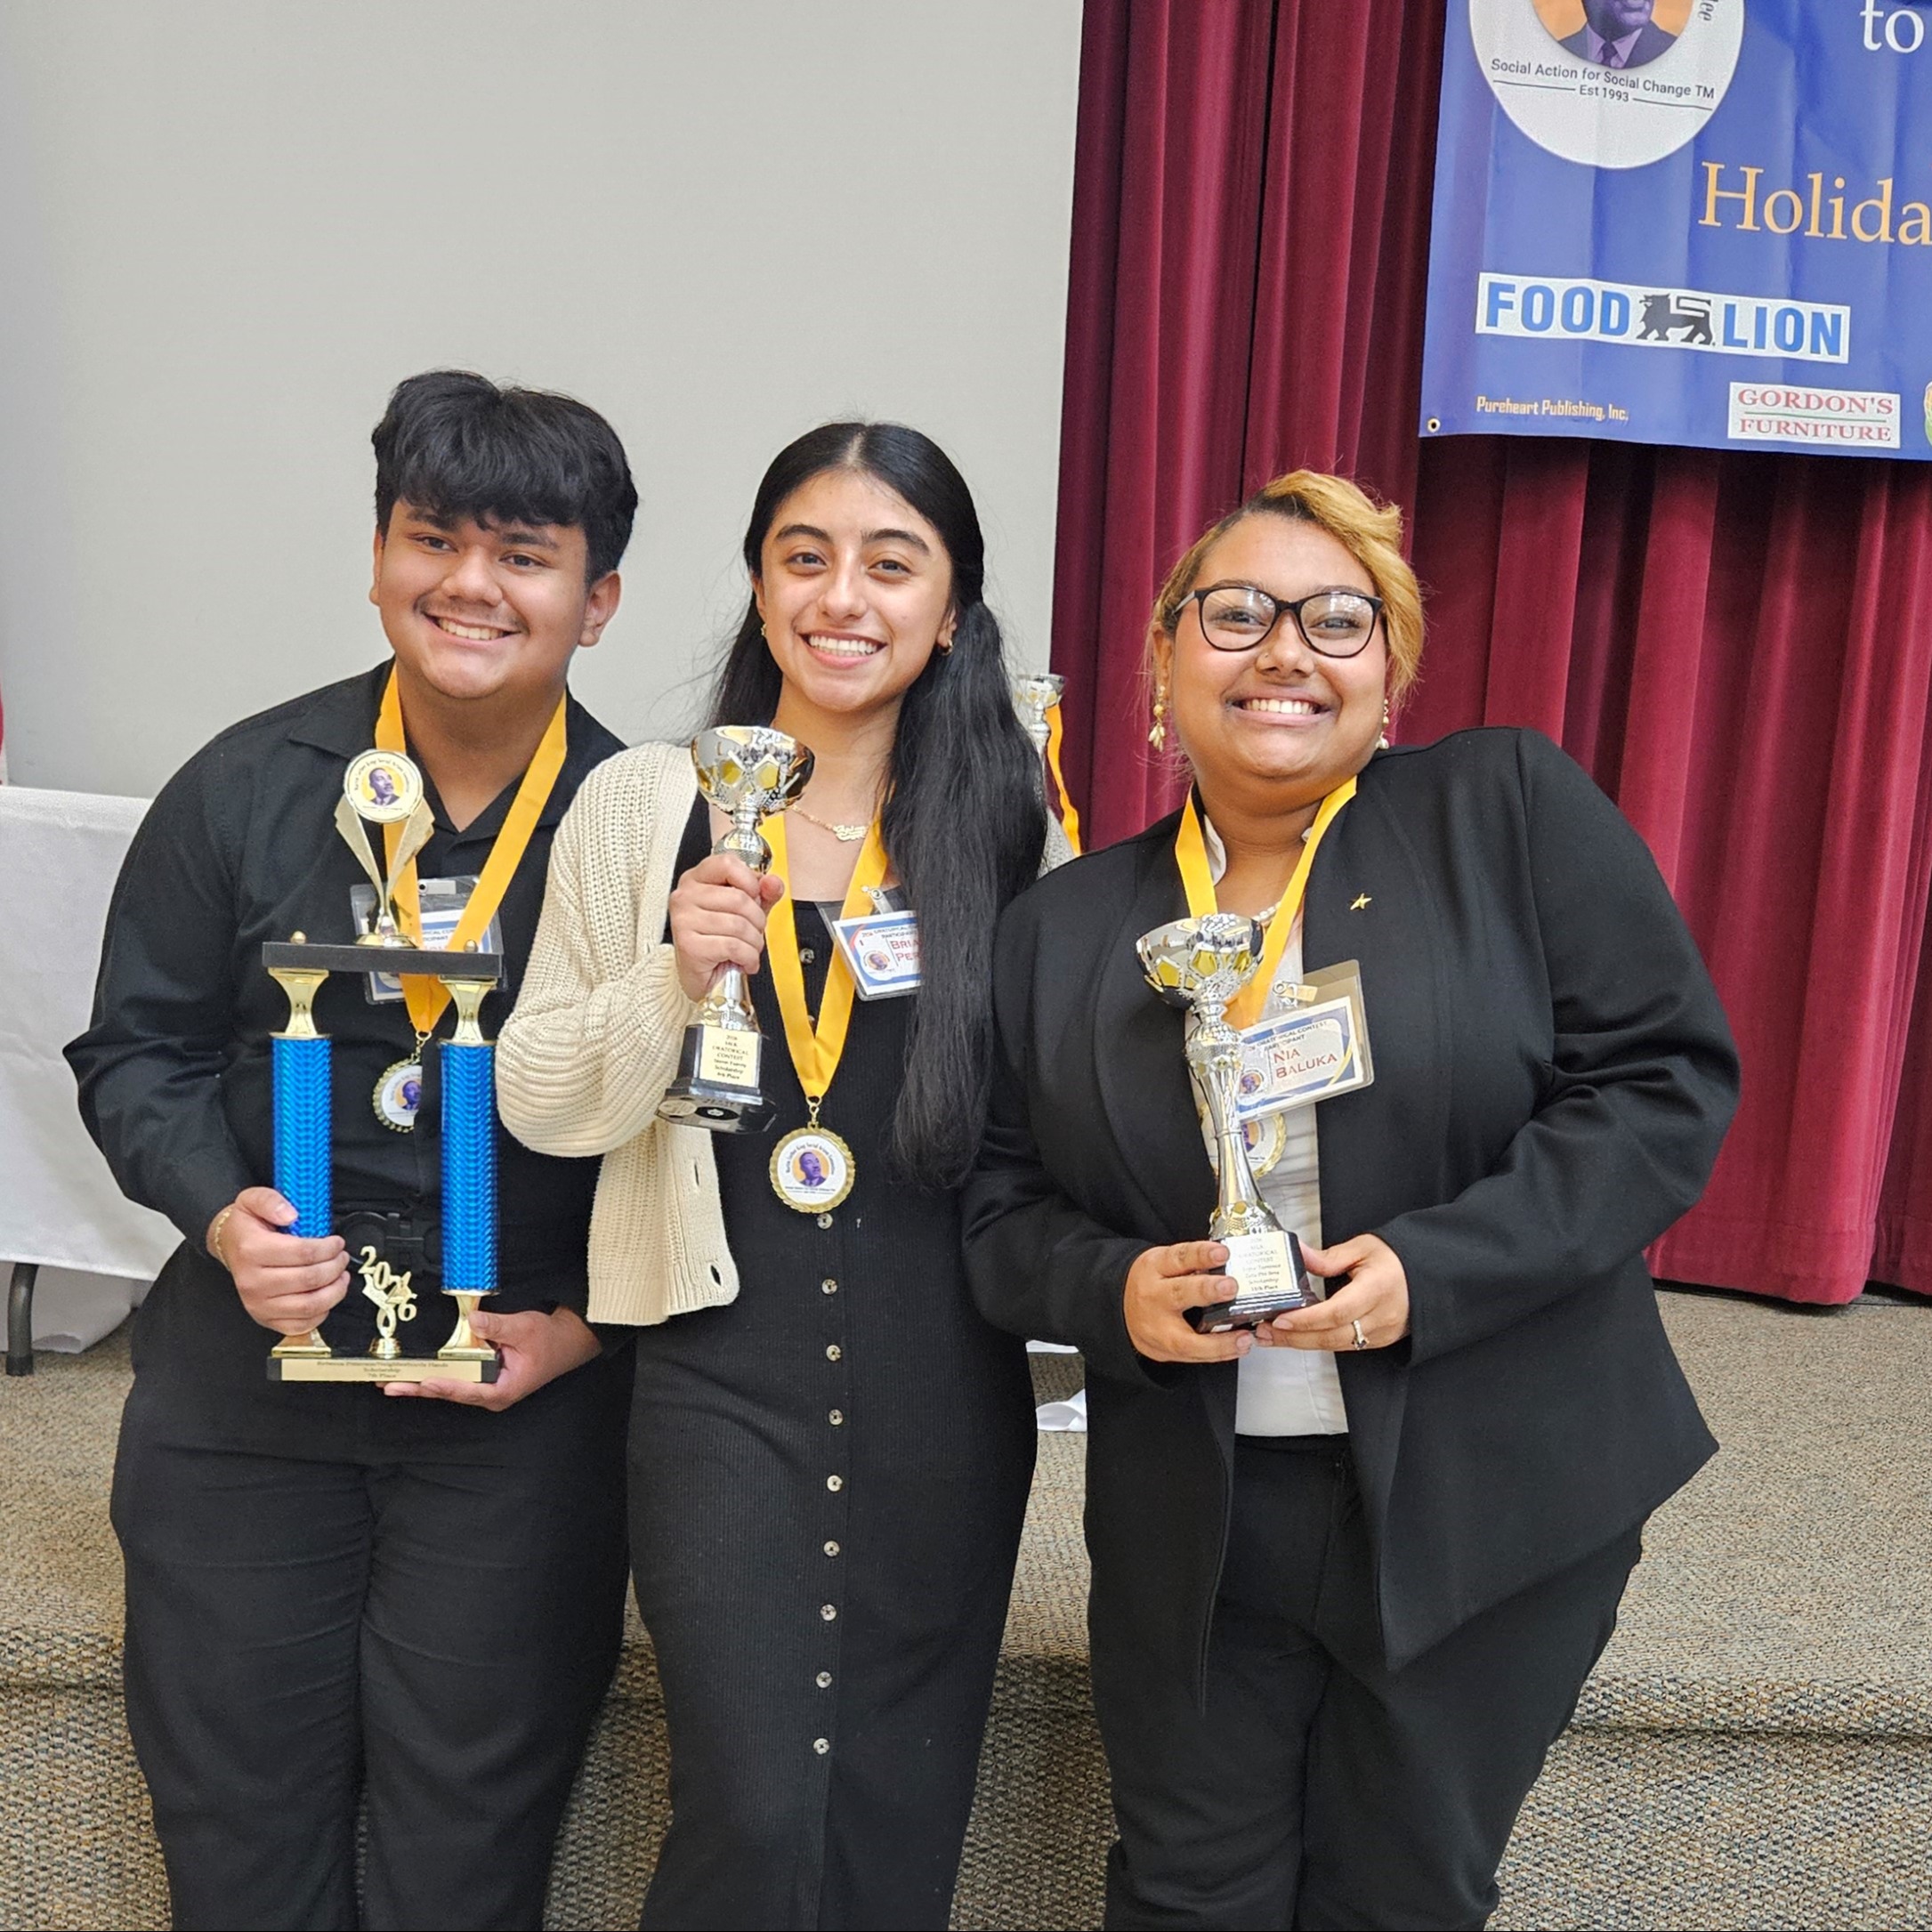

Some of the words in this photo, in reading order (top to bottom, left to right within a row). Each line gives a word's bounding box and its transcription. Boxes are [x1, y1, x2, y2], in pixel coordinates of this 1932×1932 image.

[1860, 0, 1925, 53] to
[1491, 59, 1531, 74] Social
[1535, 64, 1578, 80] Action
[1582, 68, 1601, 81] for
[1604, 71, 1639, 89] Social
[1643, 80, 1692, 98] Change
[1695, 85, 1715, 100] TM
[1580, 85, 1600, 97] Est
[1602, 87, 1629, 102] 1993
[1698, 161, 1932, 246] Holida
[1485, 281, 1630, 336] FOOD
[1722, 303, 1841, 357] LION
[1475, 396, 1540, 416] Pureheart
[1541, 400, 1605, 422] Publishing,
[1608, 403, 1629, 421] Inc.
[1737, 389, 1894, 415] GORDON'S
[1739, 418, 1892, 442] FURNITURE
[1273, 1048, 1301, 1063] NIA
[1275, 1053, 1338, 1079] BALUKA
